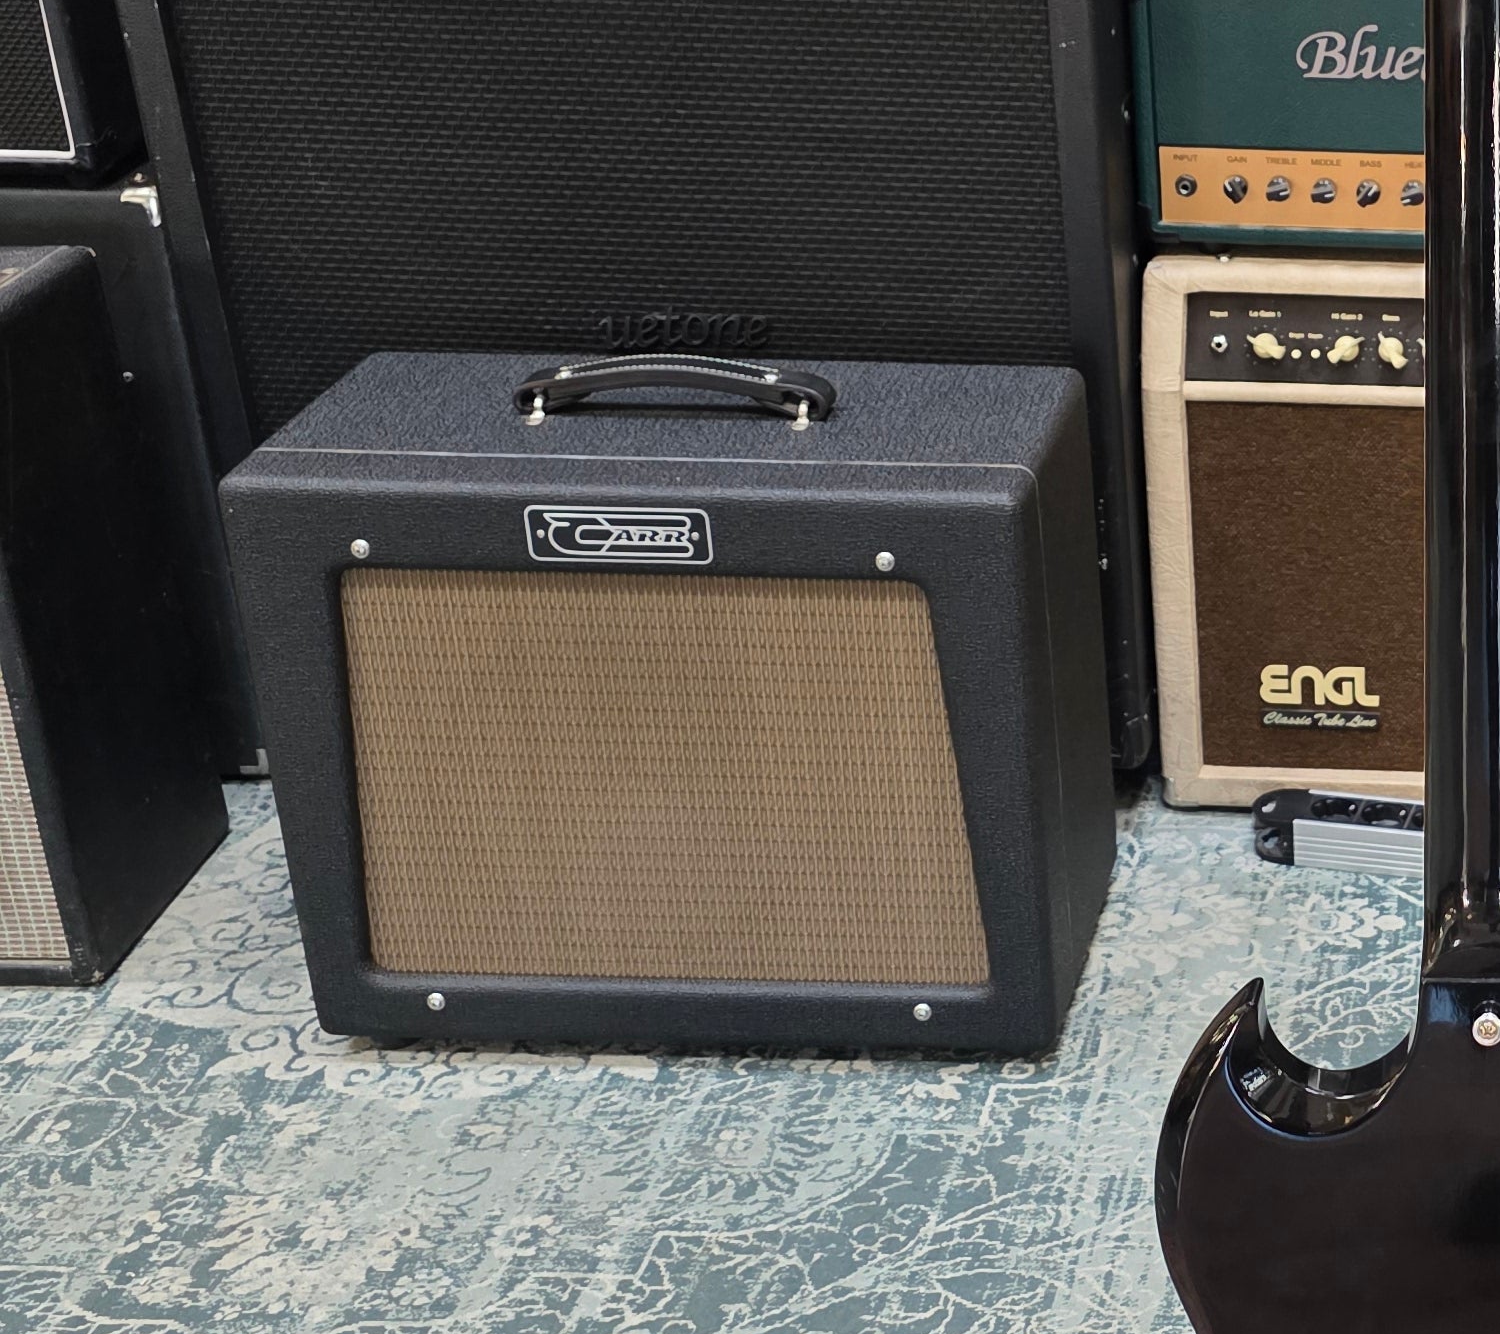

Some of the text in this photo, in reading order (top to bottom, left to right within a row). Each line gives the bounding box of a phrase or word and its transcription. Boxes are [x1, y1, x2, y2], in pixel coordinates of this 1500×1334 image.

[1295, 24, 1426, 82] Blue
[1172, 154, 1199, 163] INPUT
[1226, 156, 1248, 164] GAIN
[1265, 157, 1298, 166] TREBLE
[1310, 158, 1343, 167] MIDDLE
[1359, 160, 1383, 168] BASS
[1259, 664, 1380, 708] ENGL
[1263, 710, 1378, 728] Classic Tube Line
